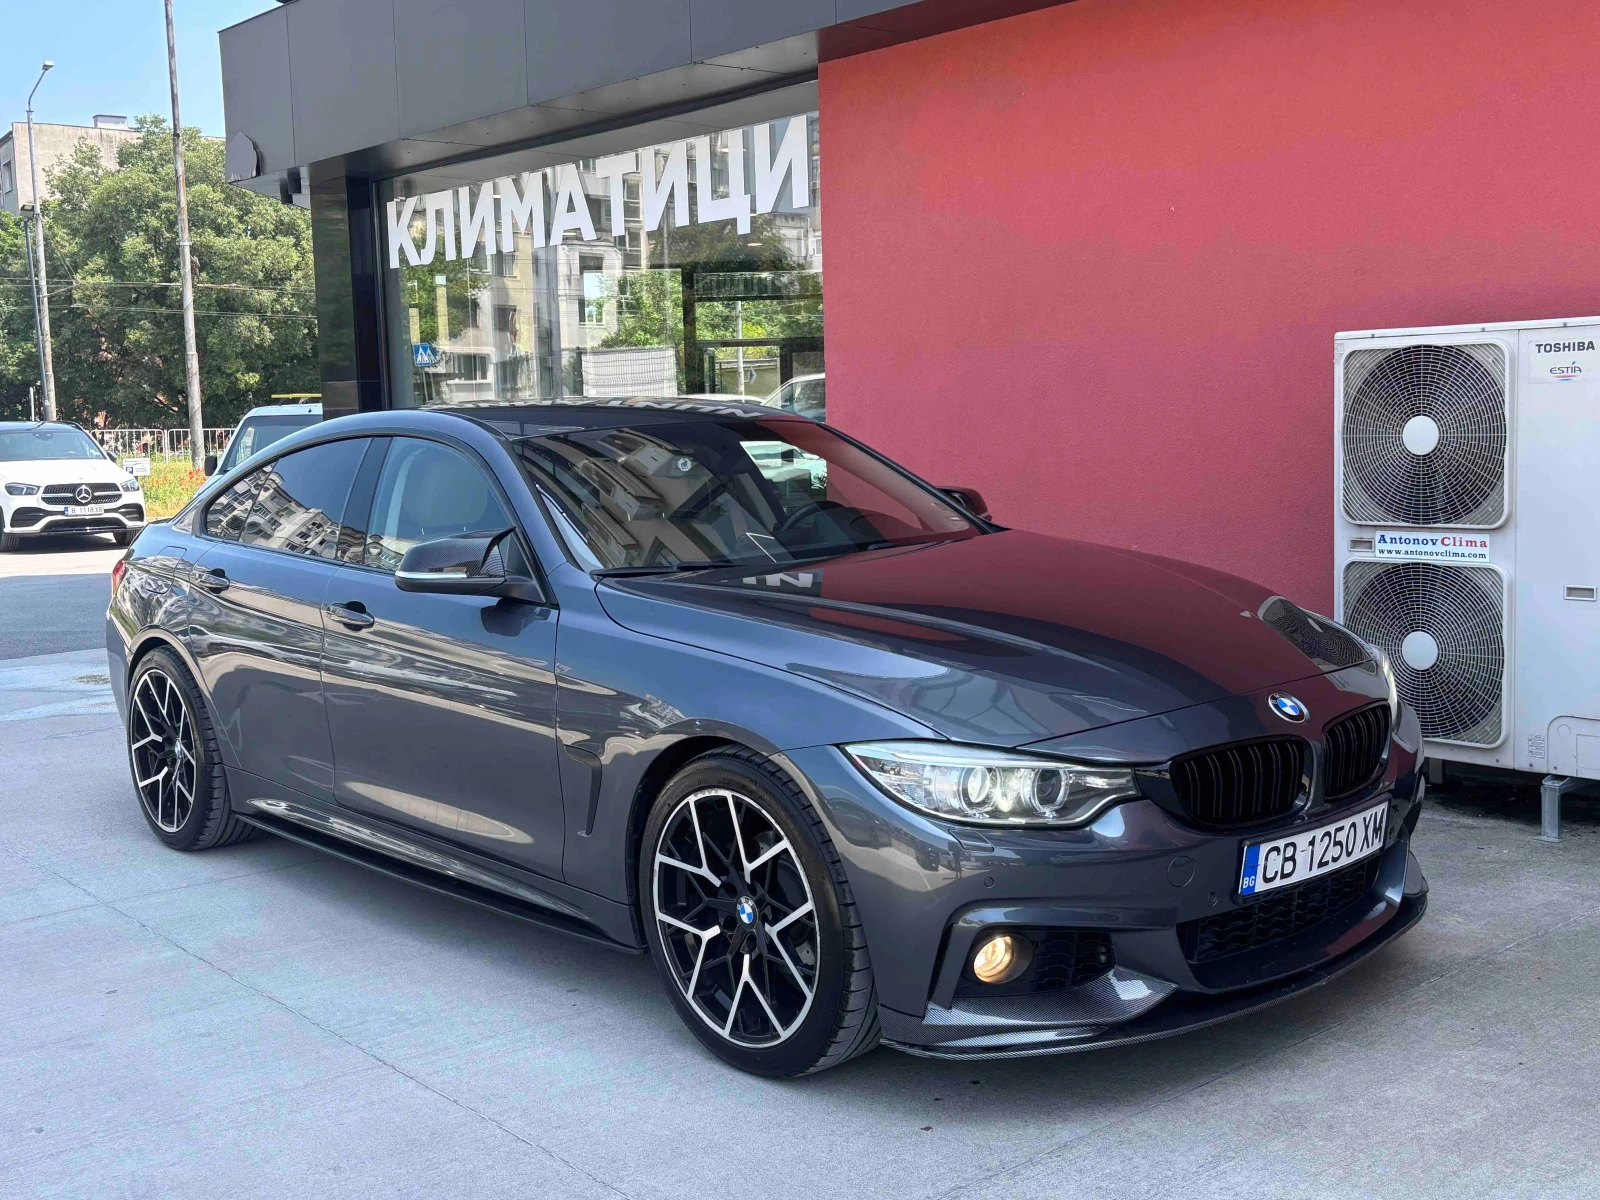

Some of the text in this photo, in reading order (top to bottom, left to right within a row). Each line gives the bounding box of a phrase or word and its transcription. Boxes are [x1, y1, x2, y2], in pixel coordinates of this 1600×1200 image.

[387, 115, 809, 269] КЛИМАТИЦИ
[1535, 340, 1596, 354] TOSHIBA
[1377, 548, 1487, 559] www.antonovclima.com
[1261, 807, 1386, 884] CB 1250 XM
[1242, 875, 1256, 889] BG
